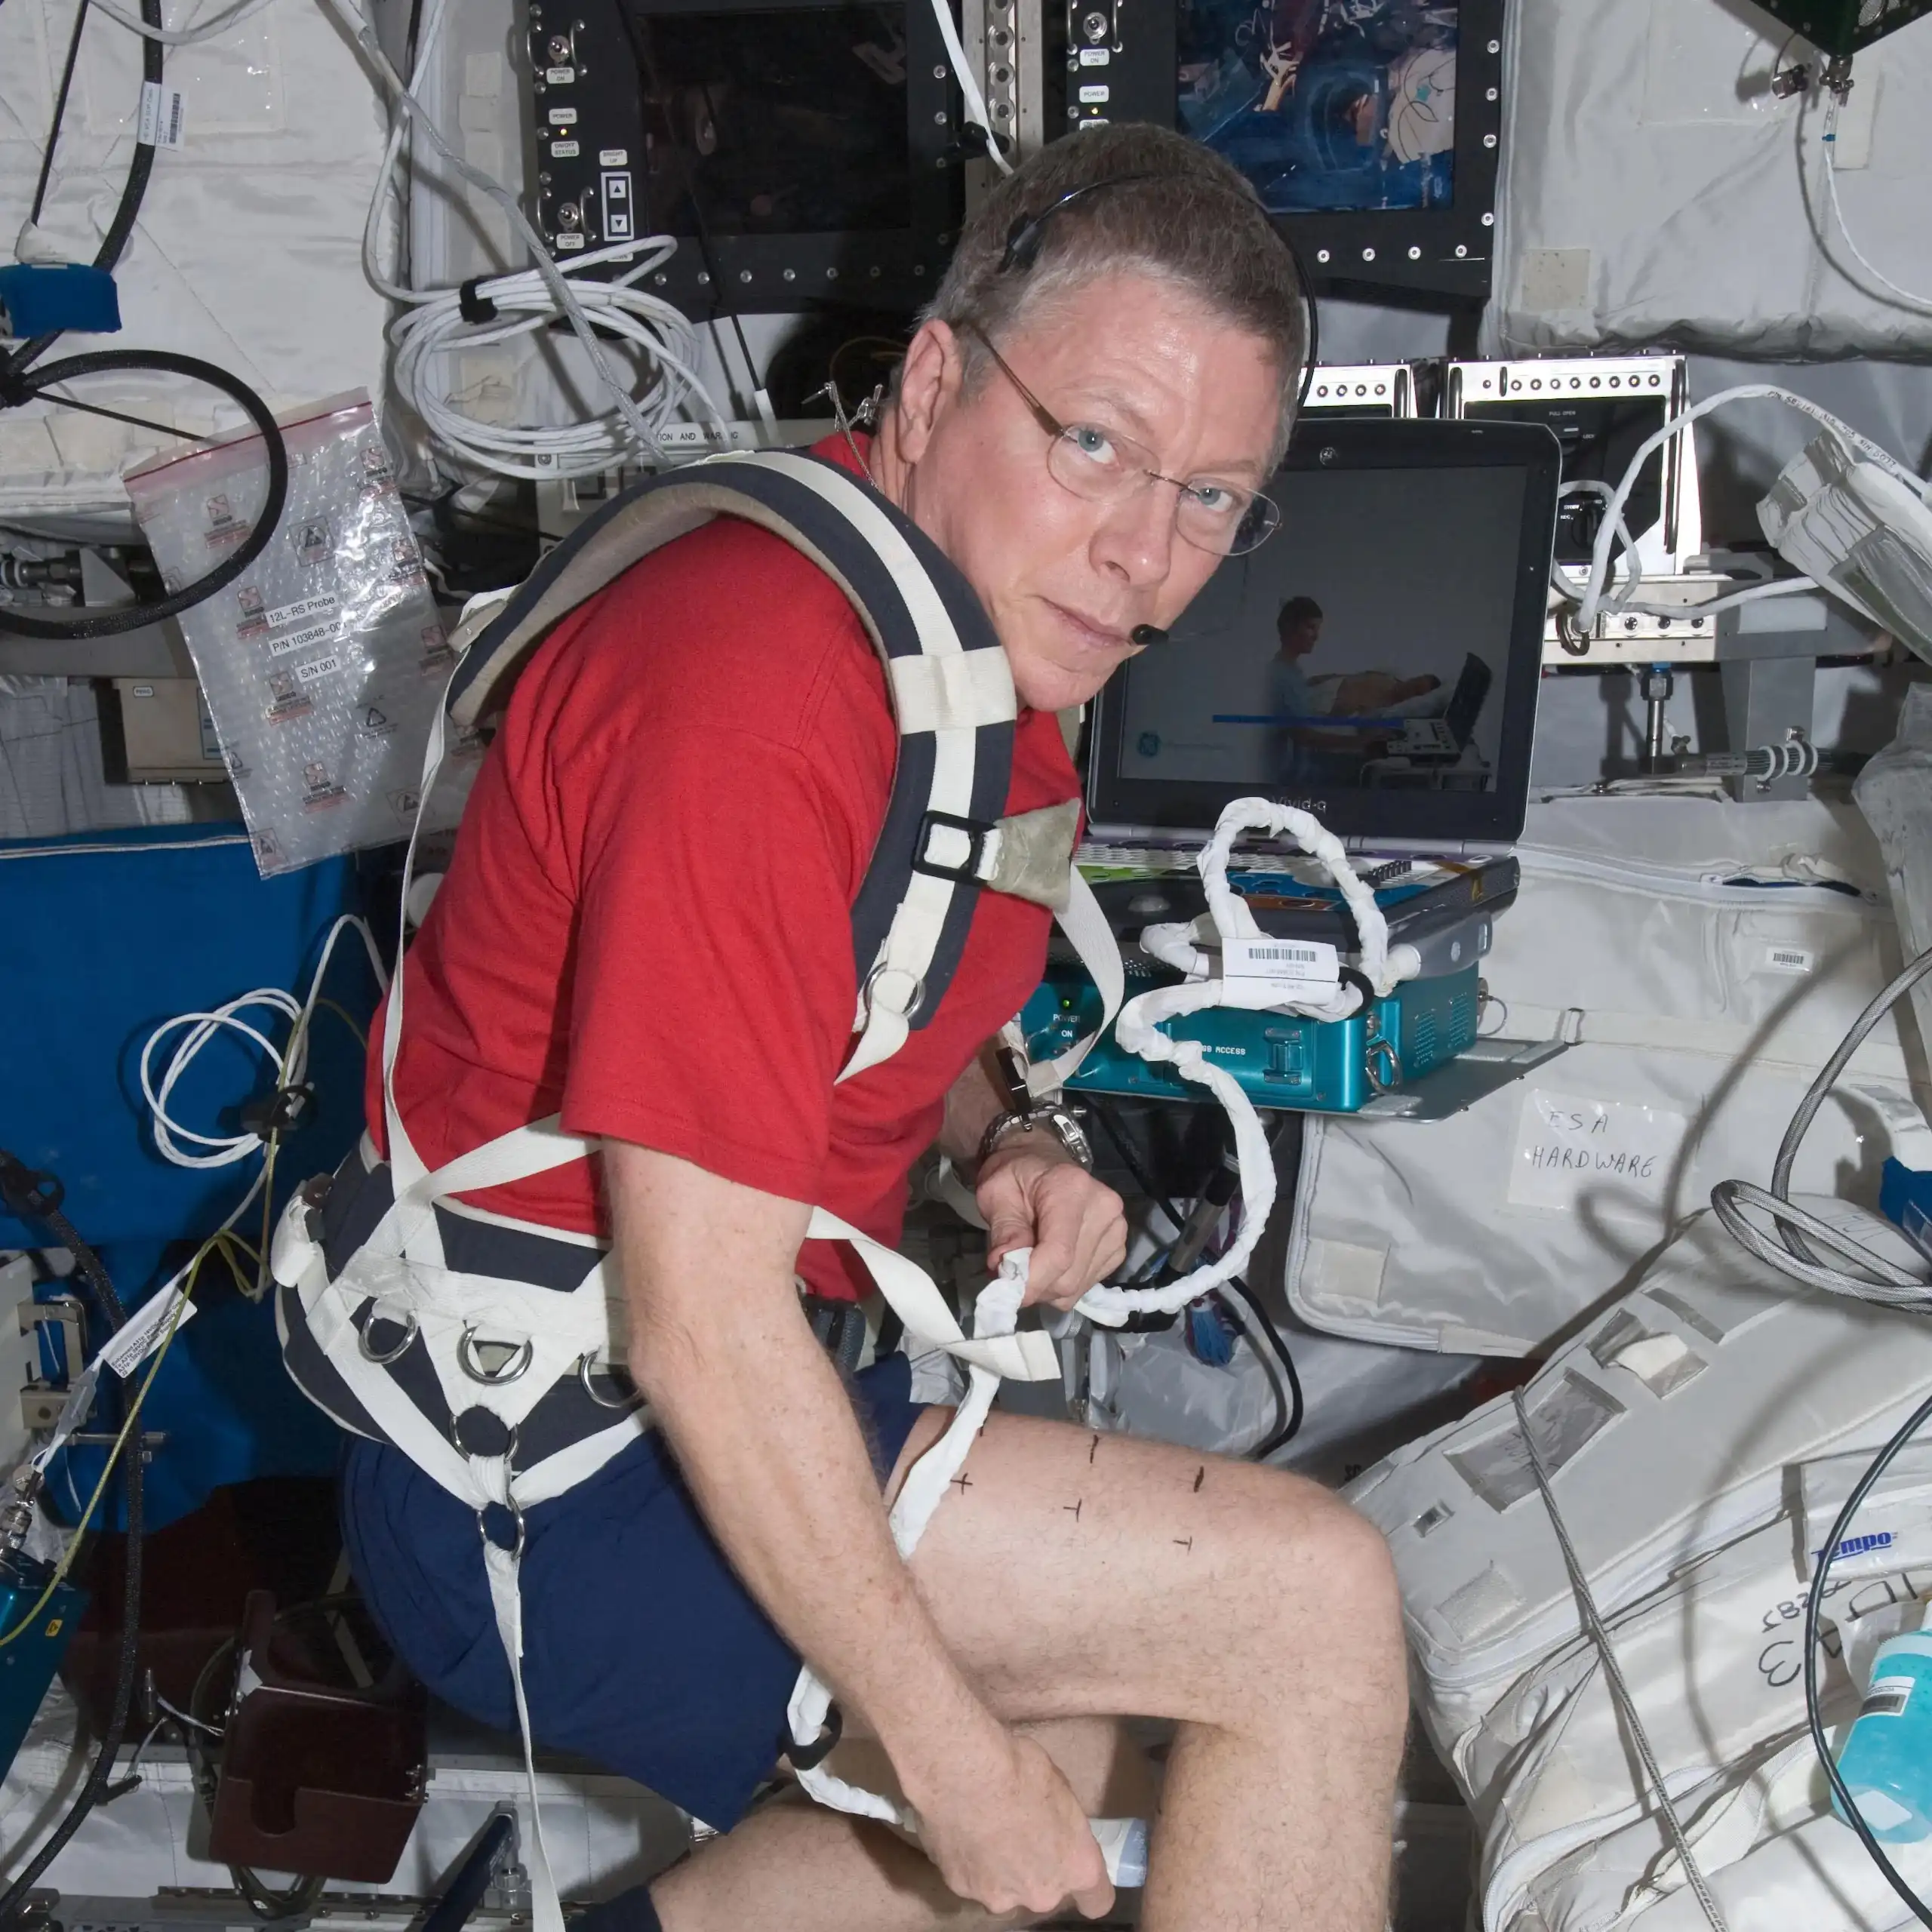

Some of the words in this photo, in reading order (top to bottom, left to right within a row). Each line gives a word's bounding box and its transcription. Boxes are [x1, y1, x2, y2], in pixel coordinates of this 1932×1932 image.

[680, 432, 696, 441] AND
[269, 605, 306, 623] 12L-RS
[307, 596, 336, 611] Probe
[272, 639, 290, 652] P/N
[300, 666, 318, 678] S/N
[319, 659, 337, 672] 001
[1053, 1014, 1081, 1023] POWER
[1061, 1029, 1072, 1038] ON
[1216, 1046, 1246, 1055] ACCESS
[1549, 1111, 1608, 1134] ESA
[1533, 1145, 1657, 1177] HARDWARE
